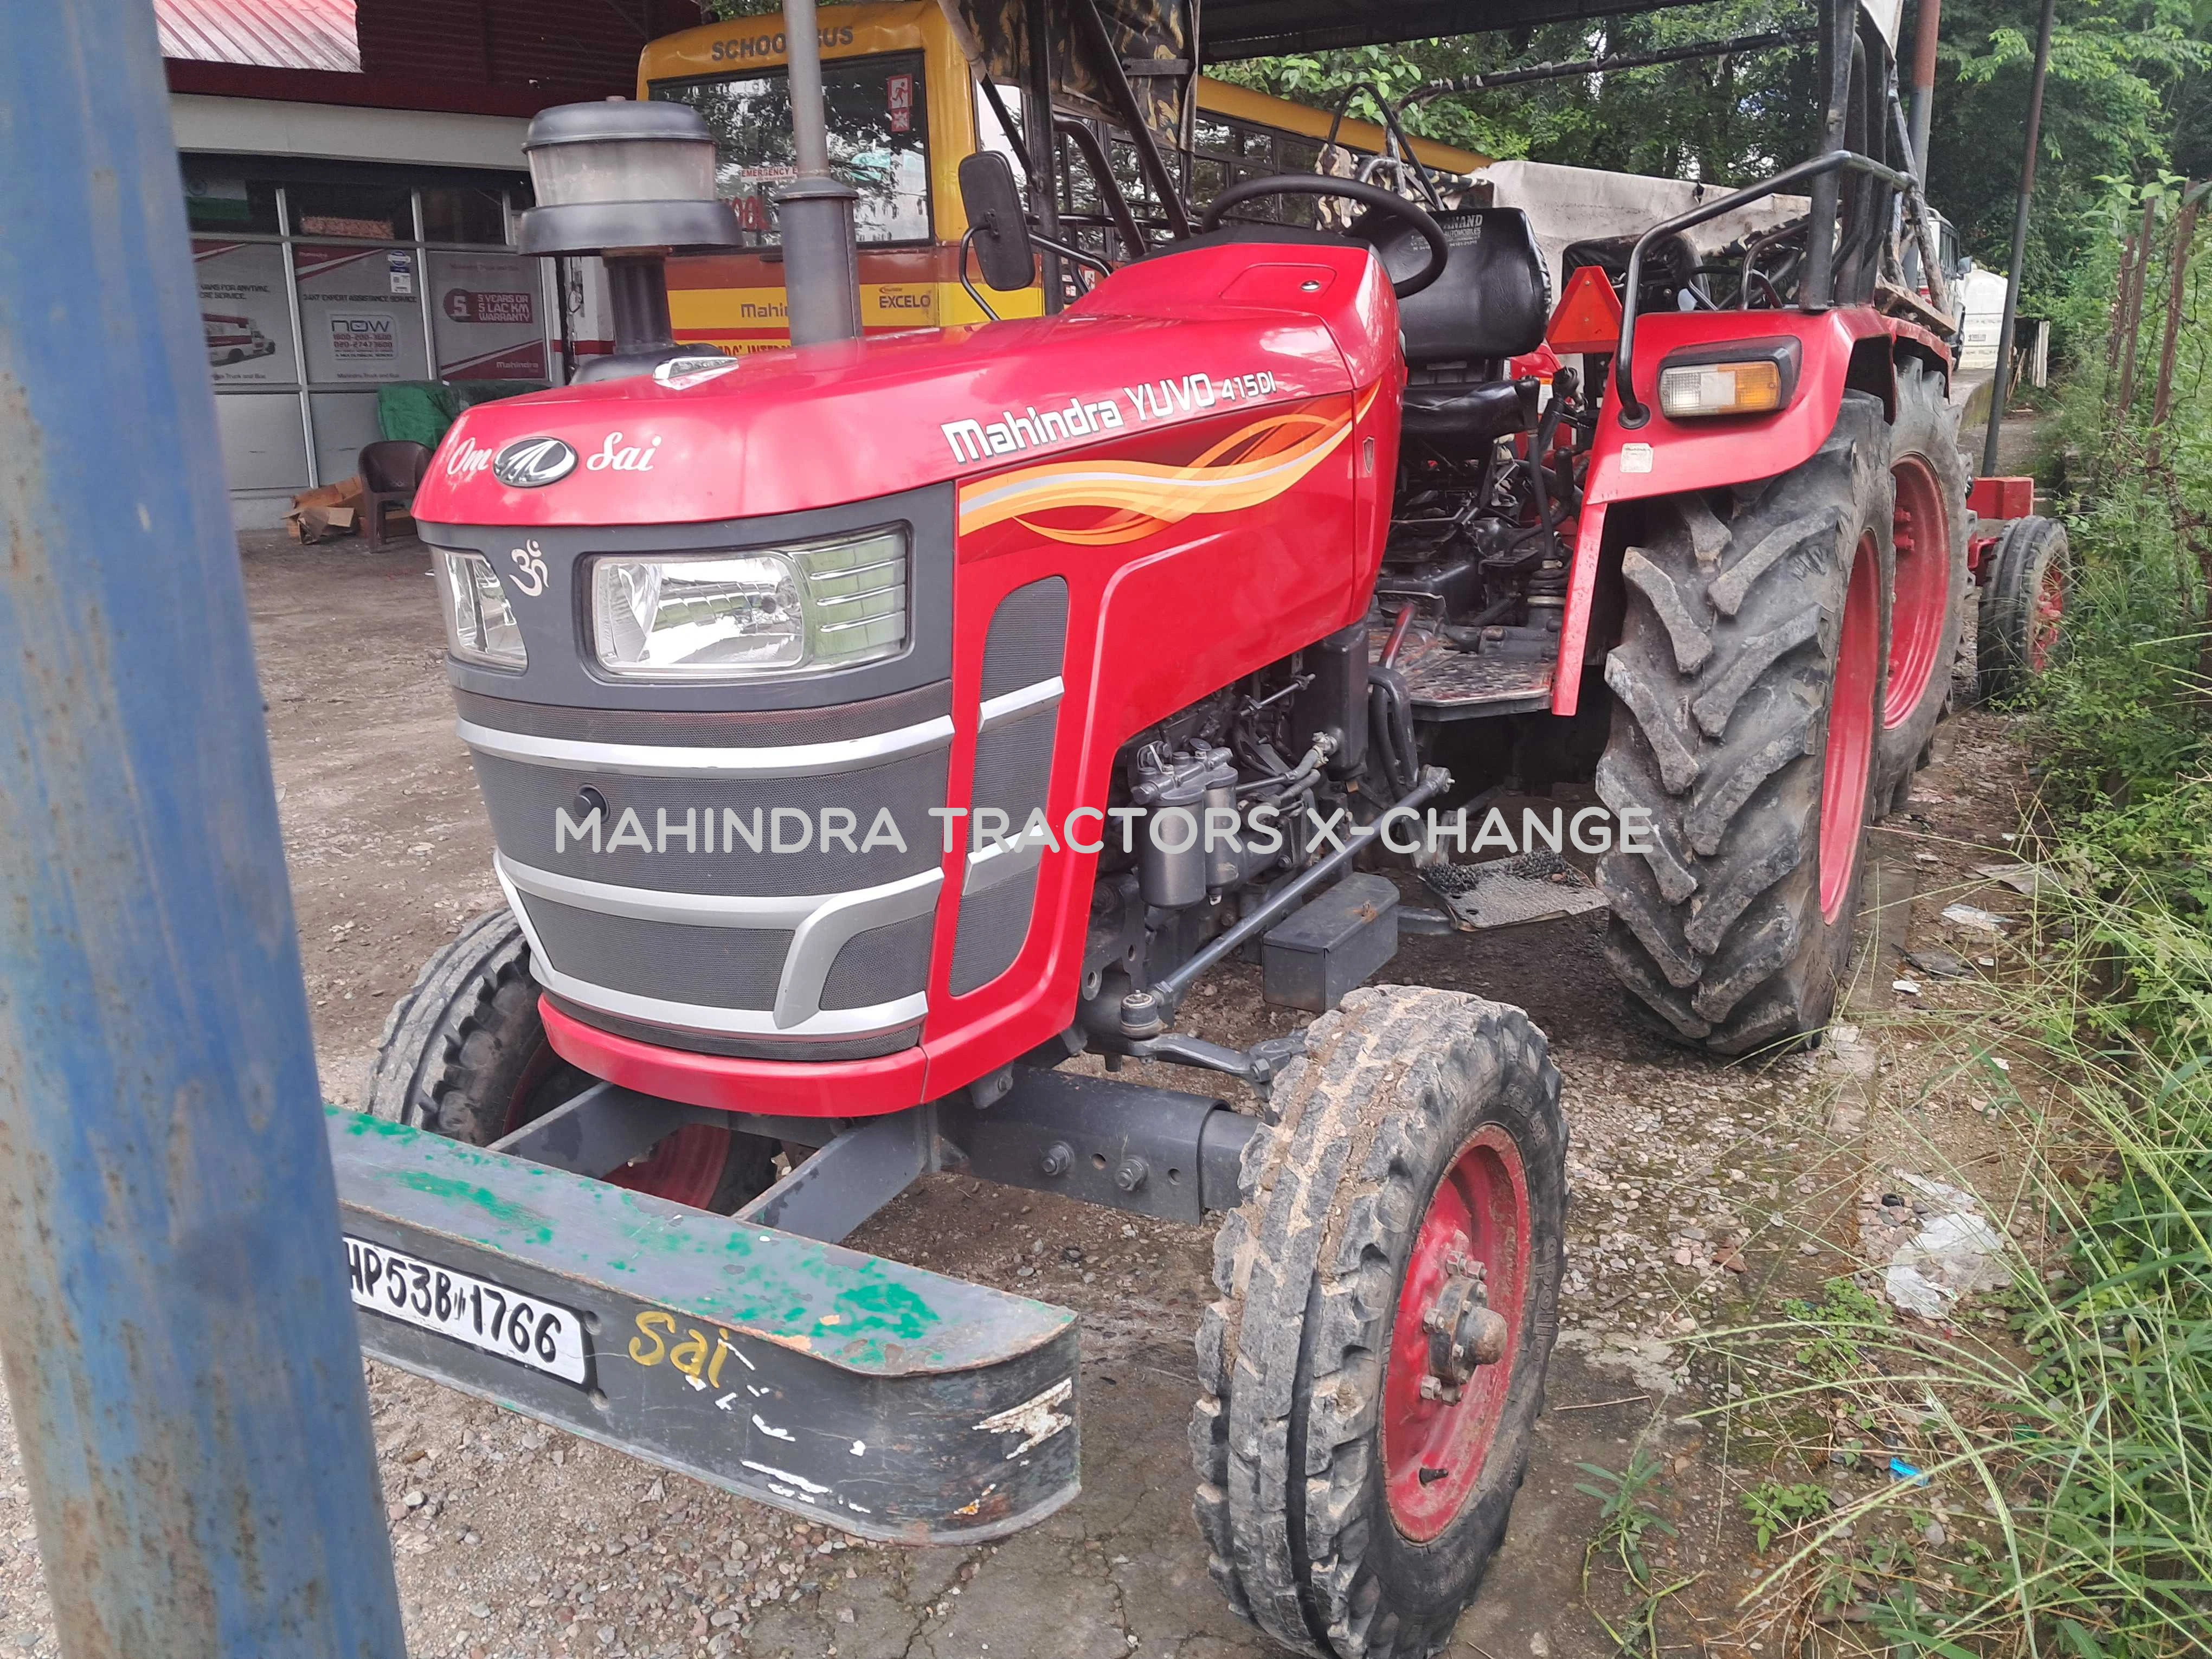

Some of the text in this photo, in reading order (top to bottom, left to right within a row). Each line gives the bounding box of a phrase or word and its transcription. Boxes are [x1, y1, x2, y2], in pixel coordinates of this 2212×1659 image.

[711, 33, 786, 61] SCHOO
[741, 166, 789, 177] EMERGENCY
[453, 295, 467, 316] 5
[479, 303, 530, 313] 5 LAC KM
[484, 294, 515, 303] YEARS
[516, 295, 528, 303] OR
[879, 294, 931, 308] EXCELO
[479, 313, 530, 321] WARRANTY
[941, 370, 1277, 465] Mahindra YUVO 415DI
[446, 432, 662, 475] Om Sai
[470, 1284, 562, 1364] 1766
[629, 1311, 729, 1388] Sai
